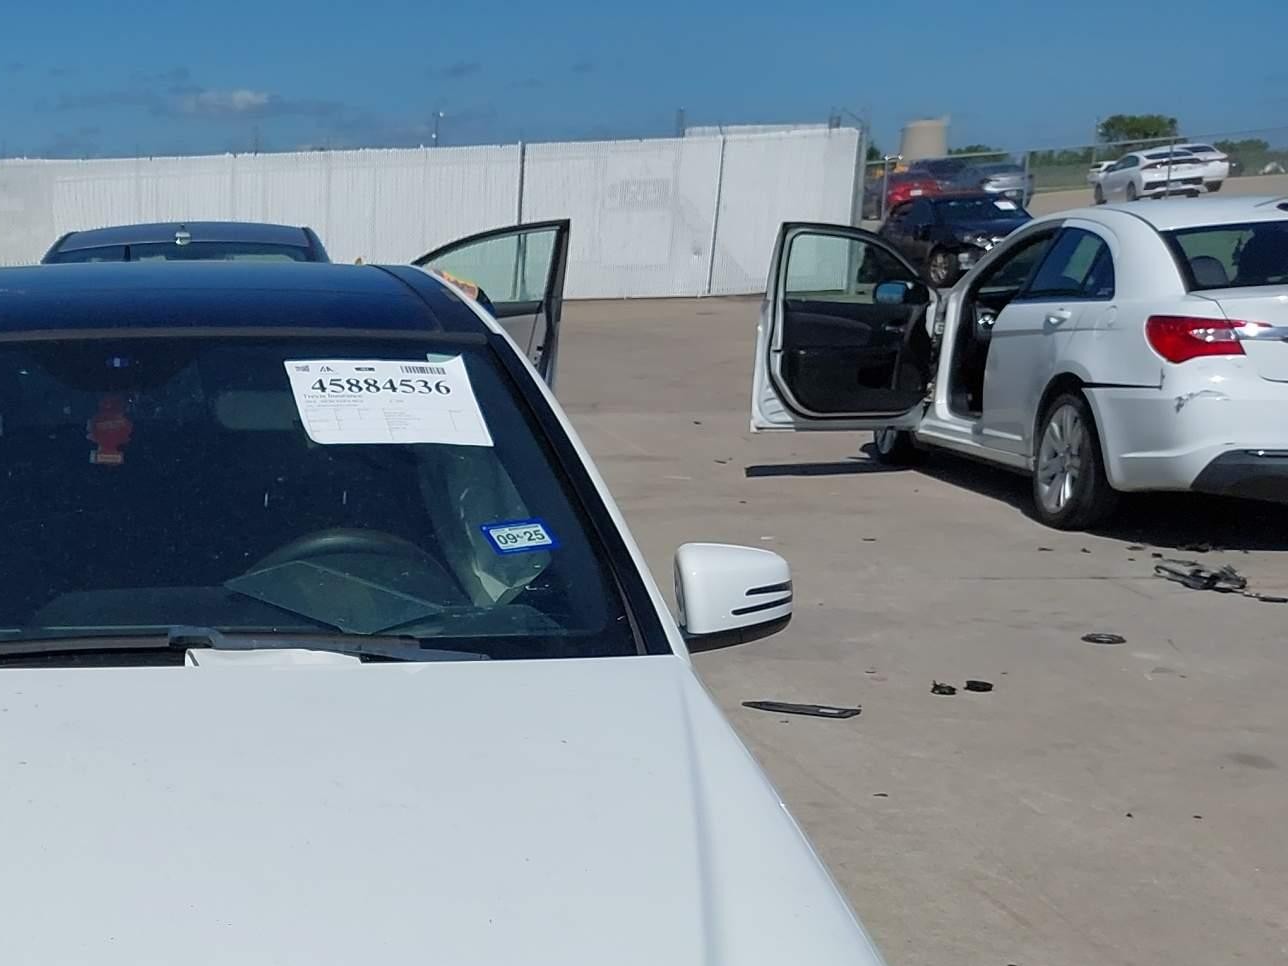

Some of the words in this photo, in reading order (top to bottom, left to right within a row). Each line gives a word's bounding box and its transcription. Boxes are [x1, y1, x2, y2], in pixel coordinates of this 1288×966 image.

[311, 378, 451, 395] 45884536
[496, 533, 518, 545] 09
[523, 529, 546, 542] 25
